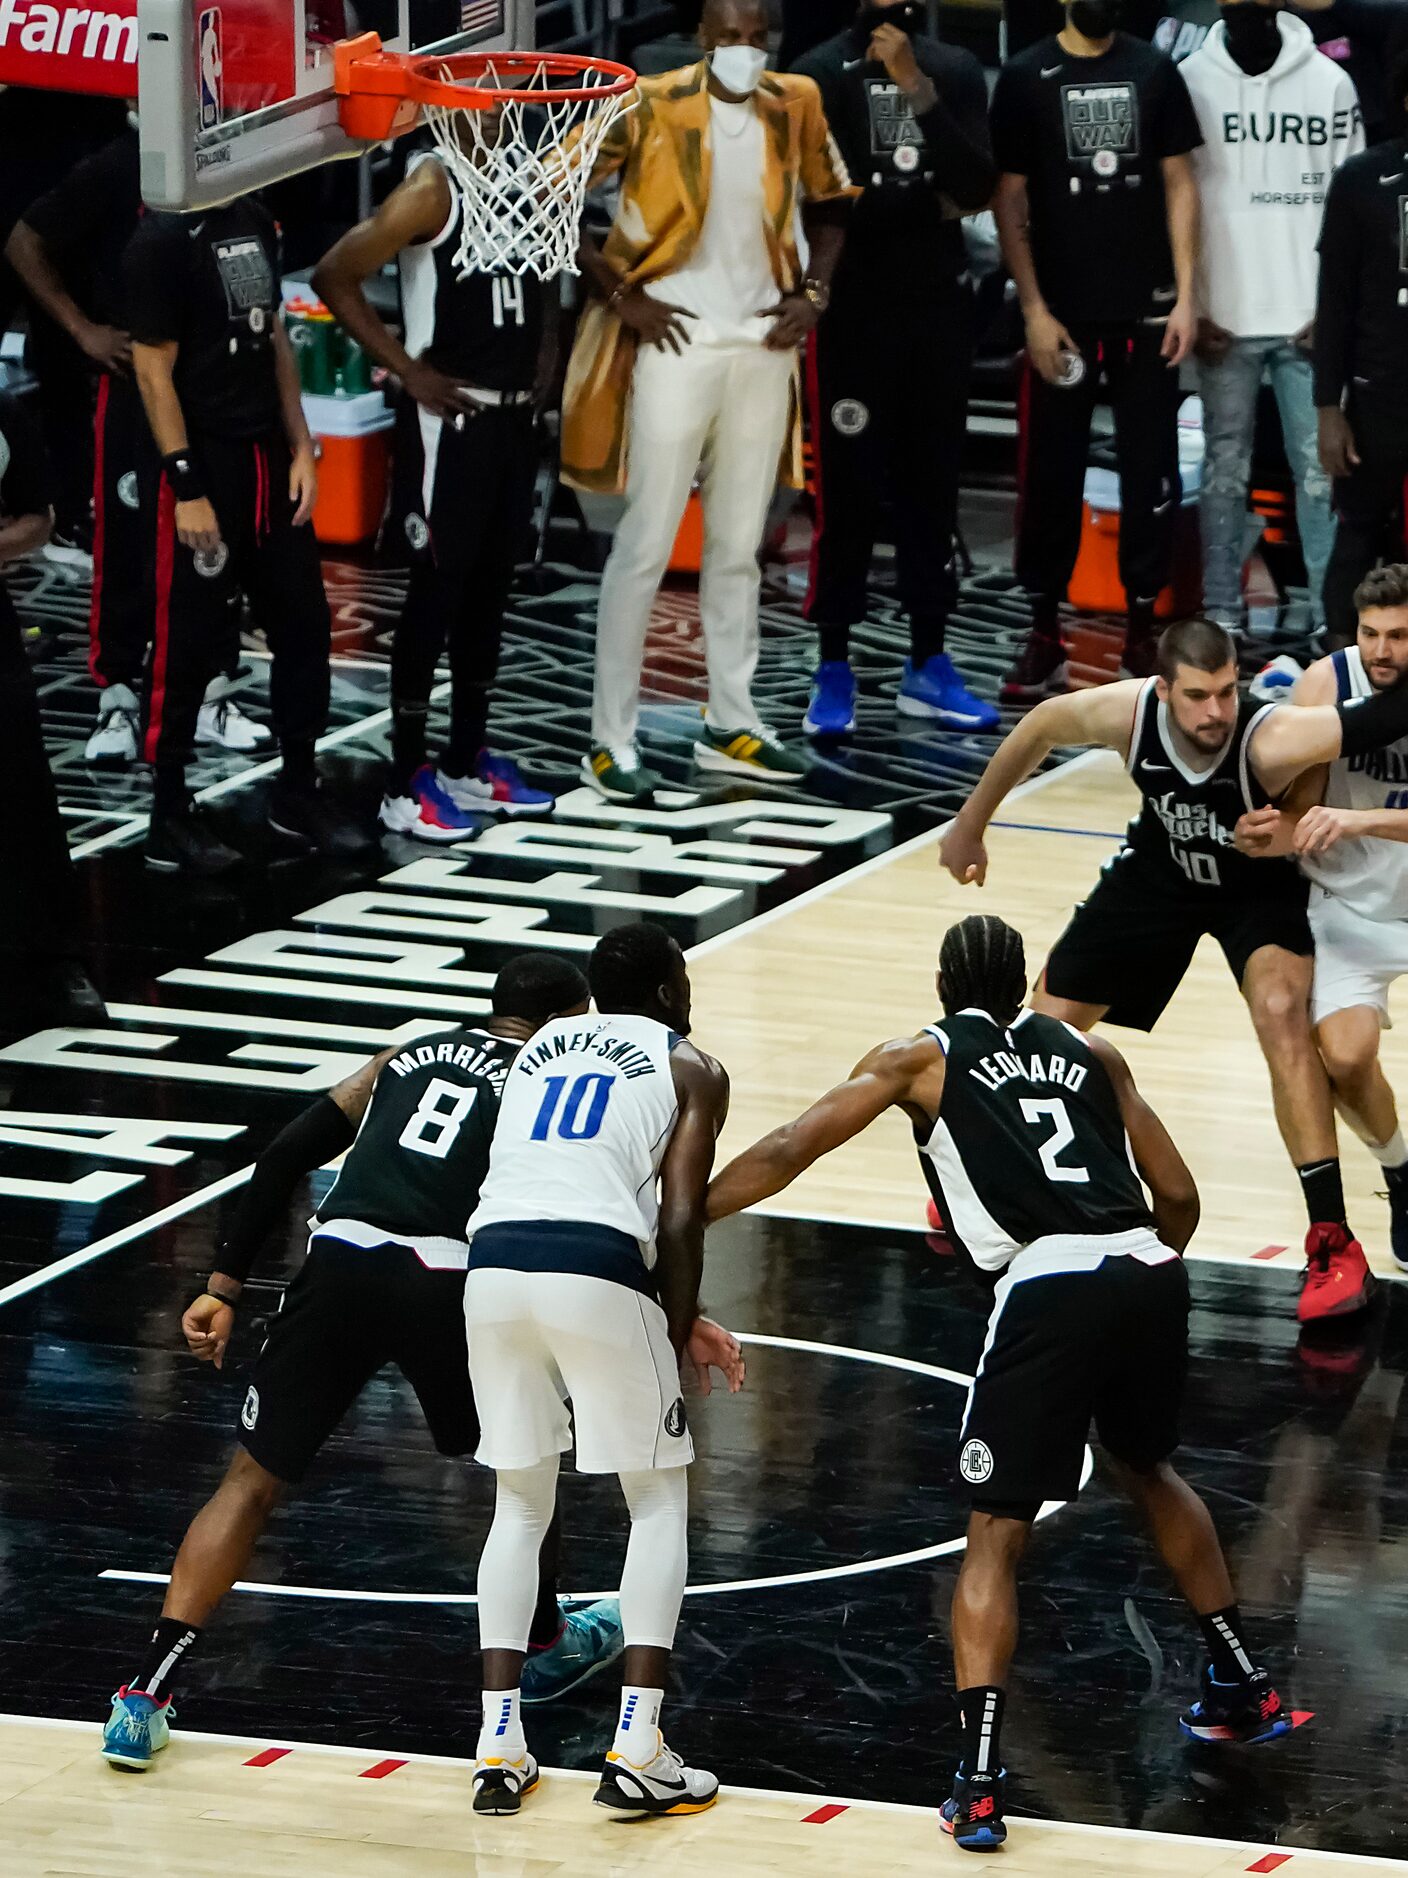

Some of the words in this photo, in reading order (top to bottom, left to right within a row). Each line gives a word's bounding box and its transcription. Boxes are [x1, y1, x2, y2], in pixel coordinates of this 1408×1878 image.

[0, 0, 138, 64] Farm
[492, 275, 525, 328] 14
[1169, 837, 1221, 886] 40
[517, 1033, 656, 1080] FINNEY-SMITH
[968, 1051, 1089, 1092] LEONARD
[399, 1077, 478, 1159] 8
[529, 1073, 616, 1142] 10
[1018, 1097, 1090, 1183] 2
